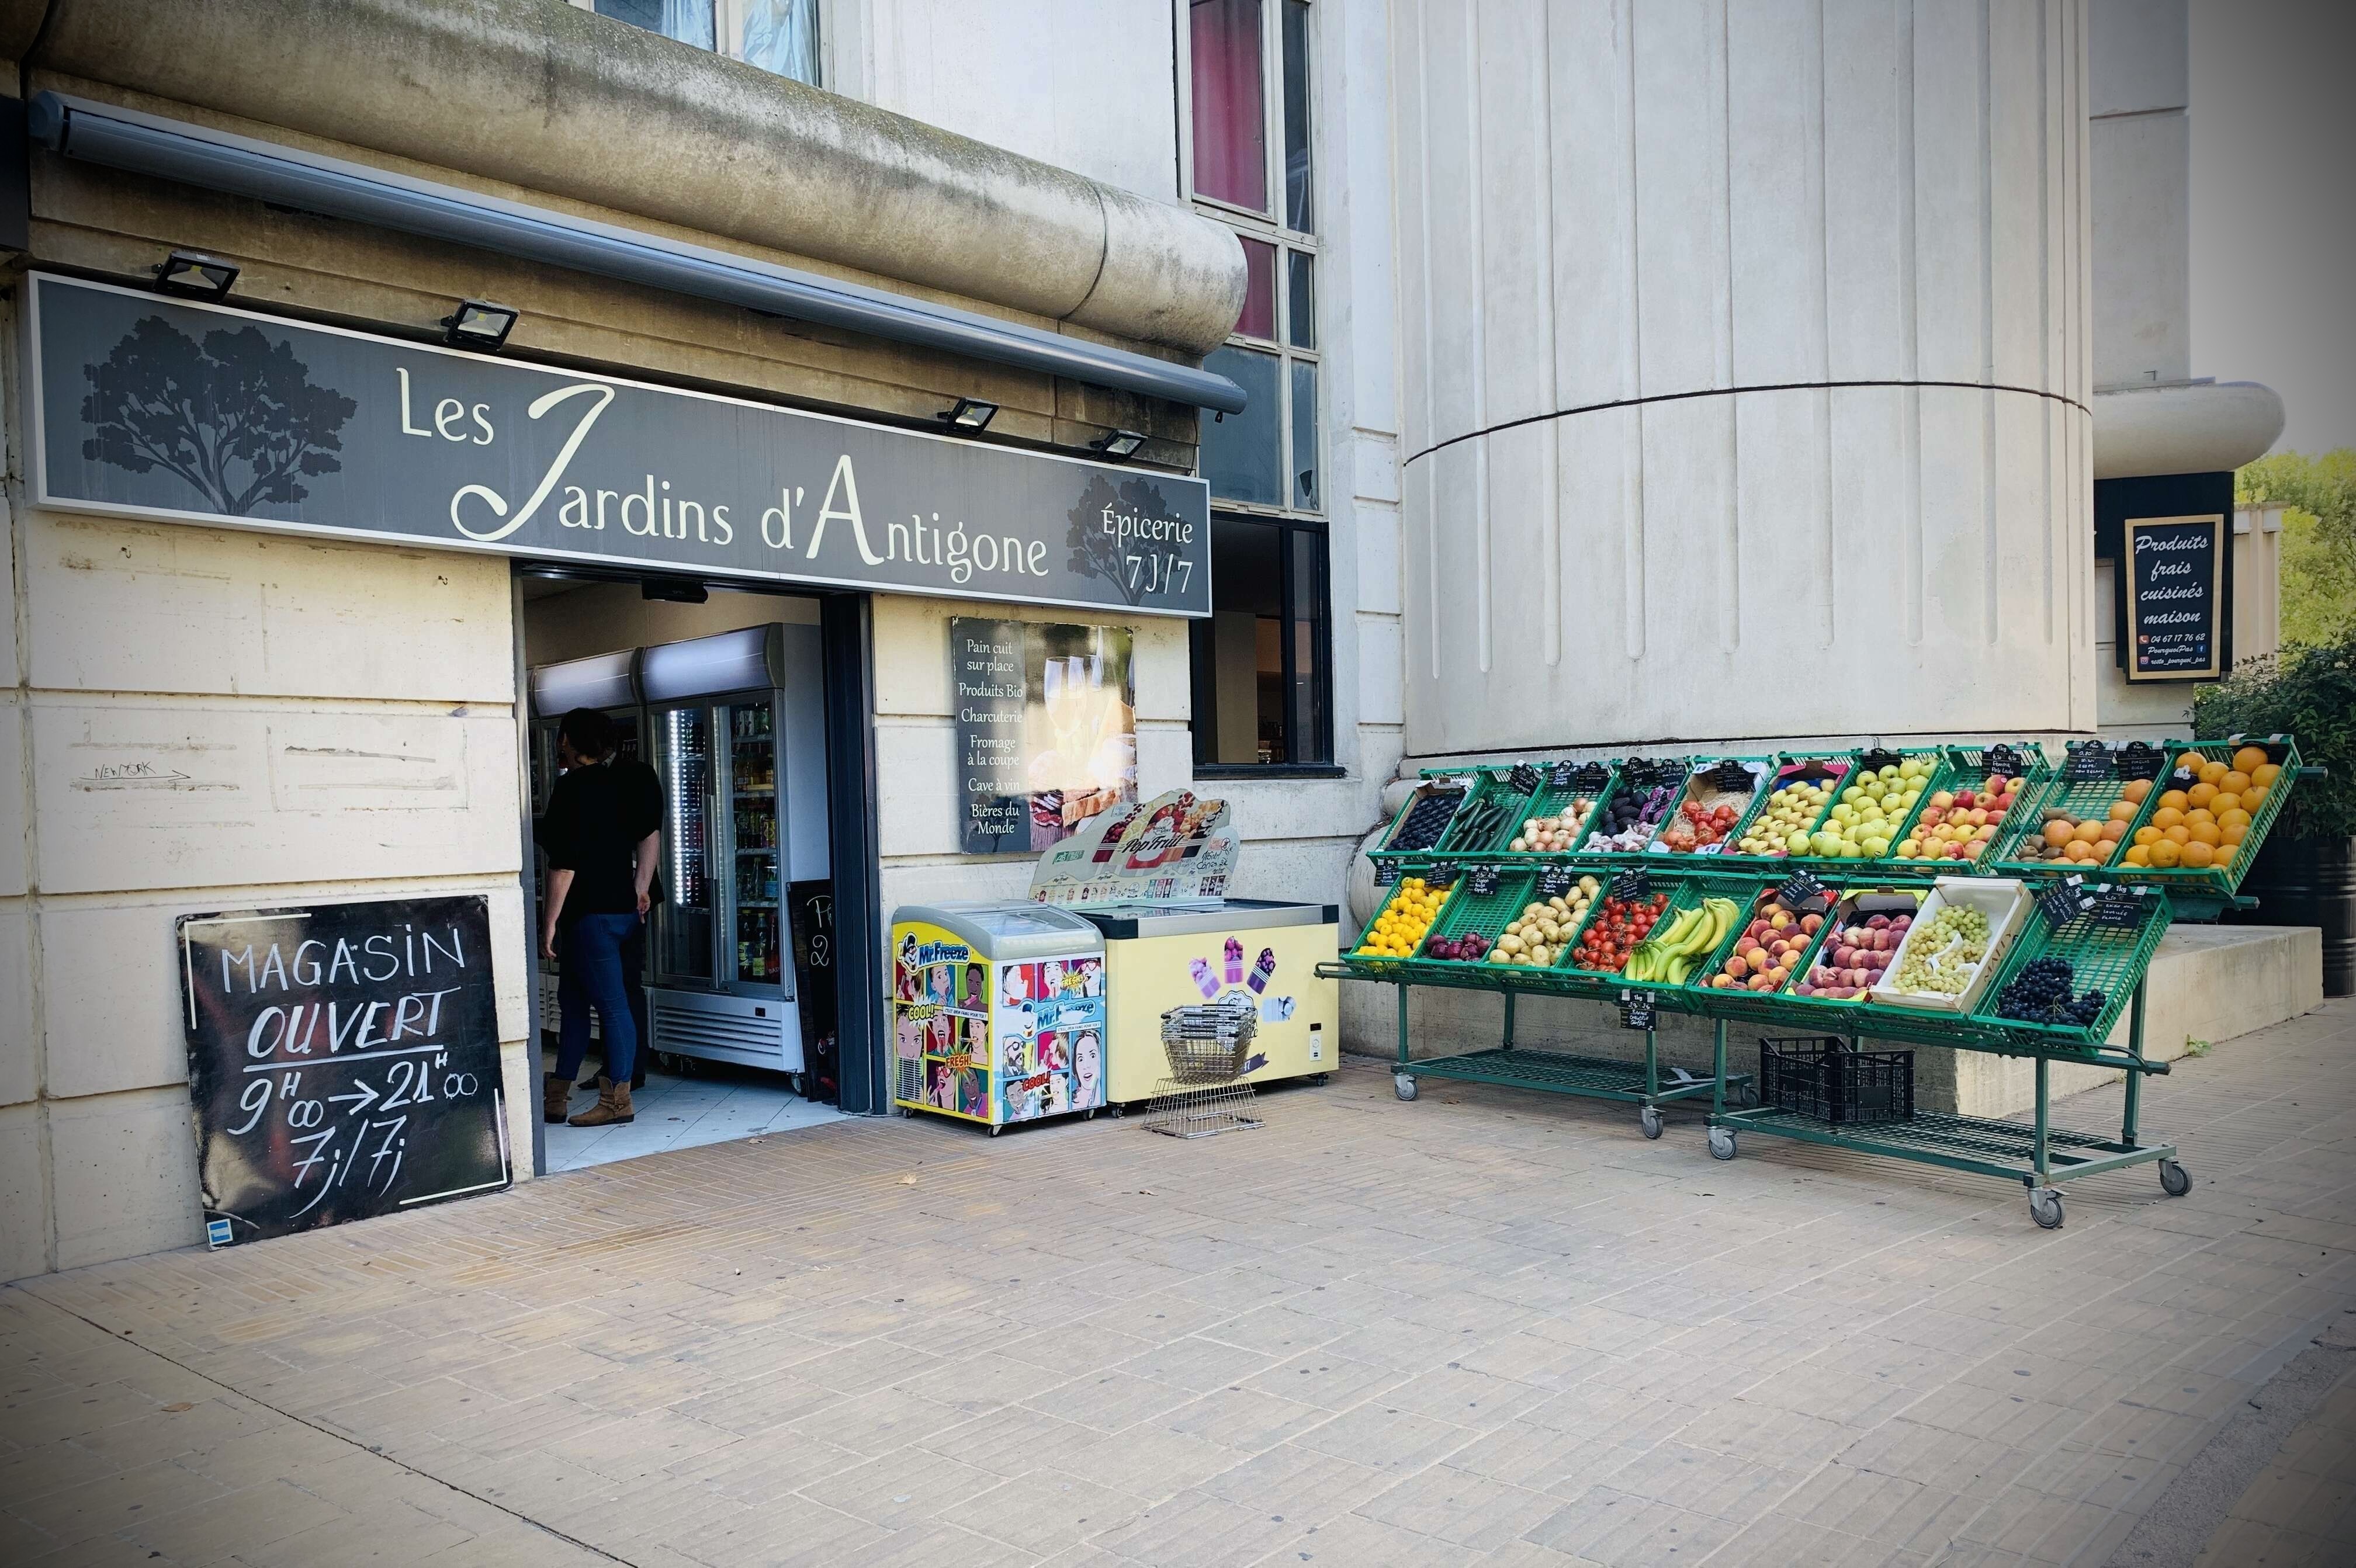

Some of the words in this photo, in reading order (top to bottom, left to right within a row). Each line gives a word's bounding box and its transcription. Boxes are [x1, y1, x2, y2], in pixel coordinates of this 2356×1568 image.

[397, 368, 493, 445] Les
[451, 384, 733, 548] Jardins
[761, 455, 1048, 583] d'Antigone
[1101, 502, 1193, 548] Épicerie
[2135, 535, 2209, 555] Produits
[2150, 560, 2192, 582] frais
[2140, 581, 2204, 601] cuisinés
[2143, 610, 2201, 625] maison
[2150, 635, 2161, 643] 04
[2162, 634, 2173, 643] 67
[2174, 634, 2183, 642] 17
[2184, 633, 2194, 641] 76
[2195, 633, 2206, 641] 62
[966, 639, 990, 654] Pain
[993, 640, 1013, 655] cuit
[2147, 644, 2194, 655] PourquoiPas
[966, 660, 985, 671] sur
[986, 656, 1014, 676] place
[958, 681, 1004, 698] Produits
[1006, 683, 1023, 698] Bio
[961, 706, 1023, 723] Charcuterie
[969, 734, 1016, 753] Fromage
[967, 752, 975, 766] à
[977, 750, 987, 765] la
[989, 756, 1020, 770] coupe
[968, 778, 994, 792] Cave
[996, 778, 1002, 791] à
[1004, 779, 1020, 790] vin
[971, 803, 1003, 817] Bières
[1005, 801, 1020, 816] du
[978, 818, 1015, 834] Monde
[1122, 838, 1149, 855] Pop
[1146, 835, 1186, 851] Fruit
[2116, 884, 2127, 893] 1kg
[908, 1004, 935, 1021] COOL!
[247, 986, 462, 1058] OUVERT
[946, 1054, 971, 1068] FRESH!
